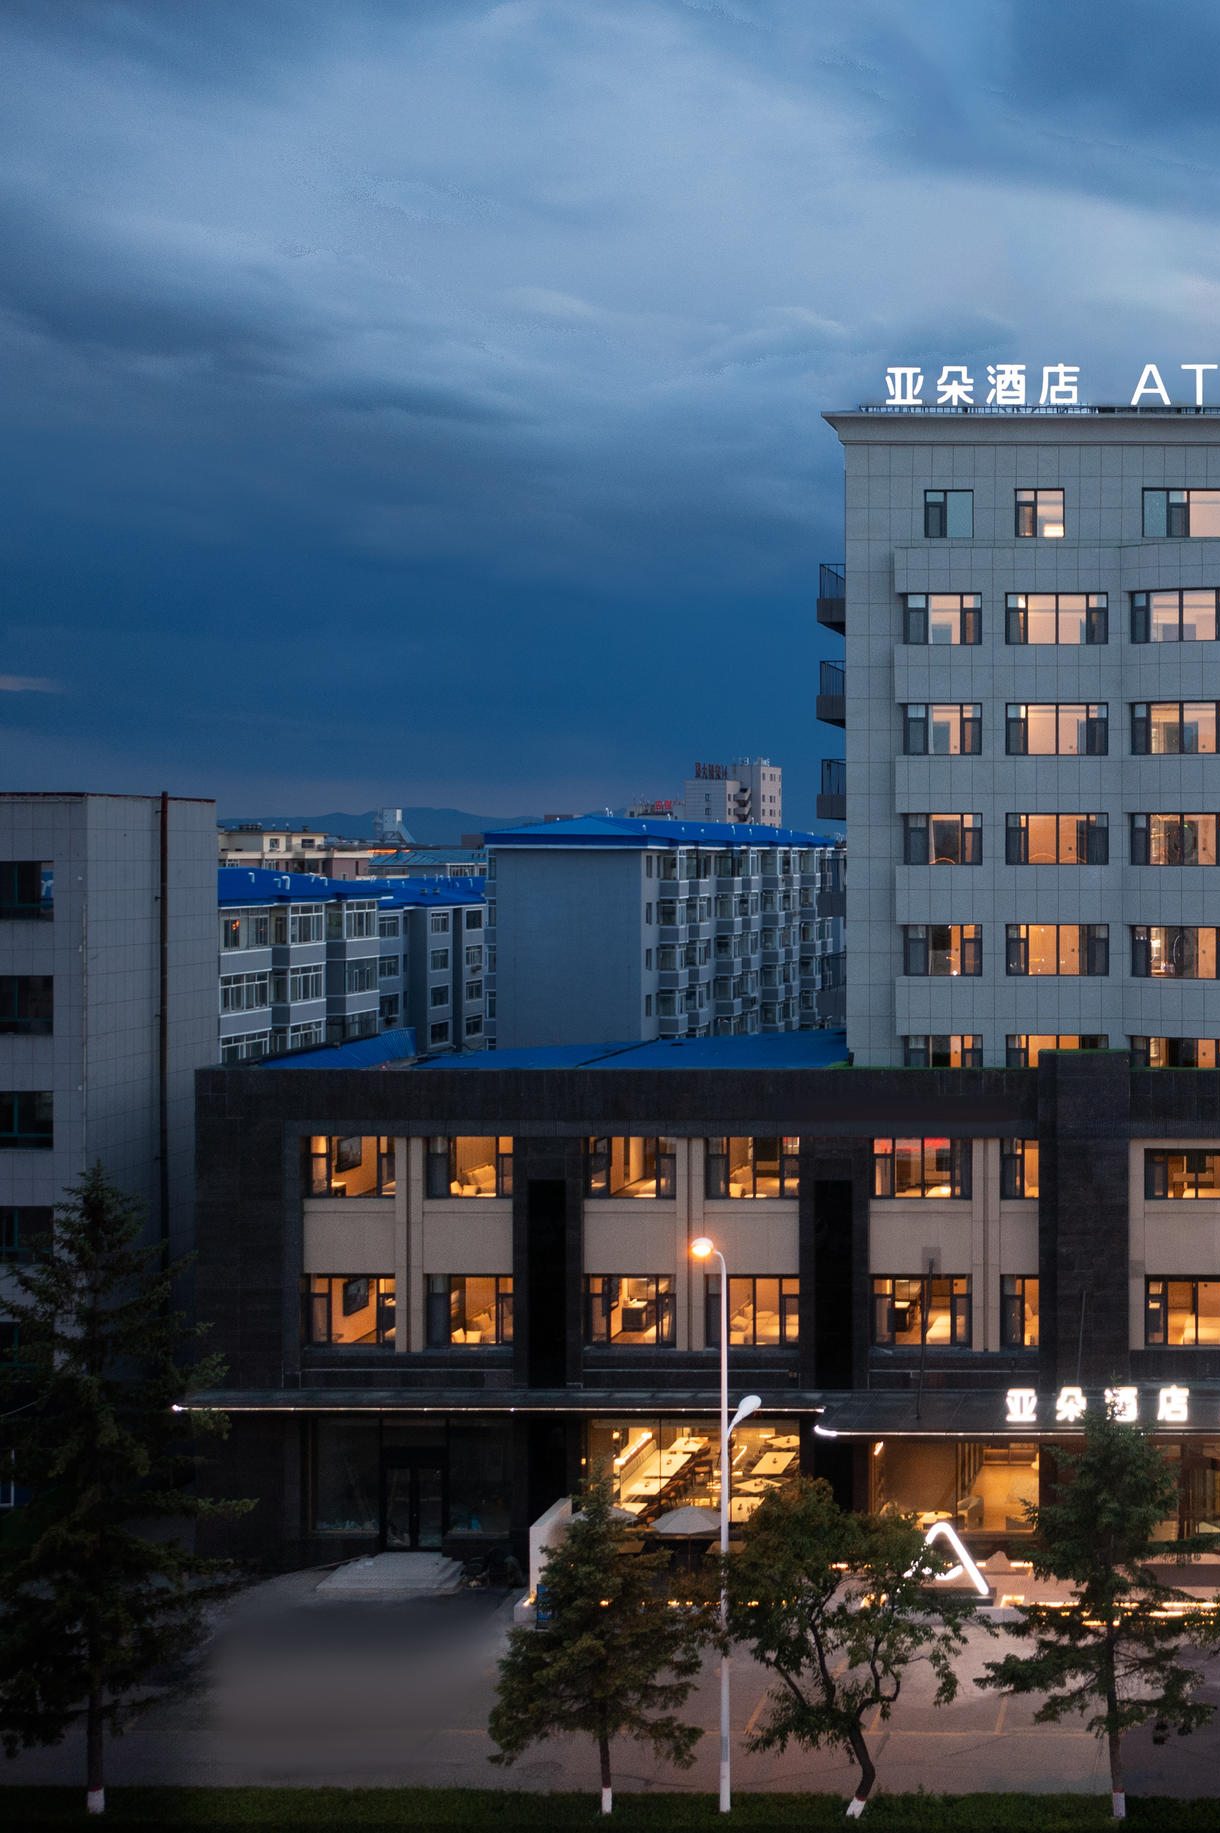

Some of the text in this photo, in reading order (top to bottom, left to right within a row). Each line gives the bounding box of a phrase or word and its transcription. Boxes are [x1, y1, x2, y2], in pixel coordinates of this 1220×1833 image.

[885, 362, 1080, 406] 亚朵酒店
[1005, 1385, 1191, 1423] 亚朵酒店
